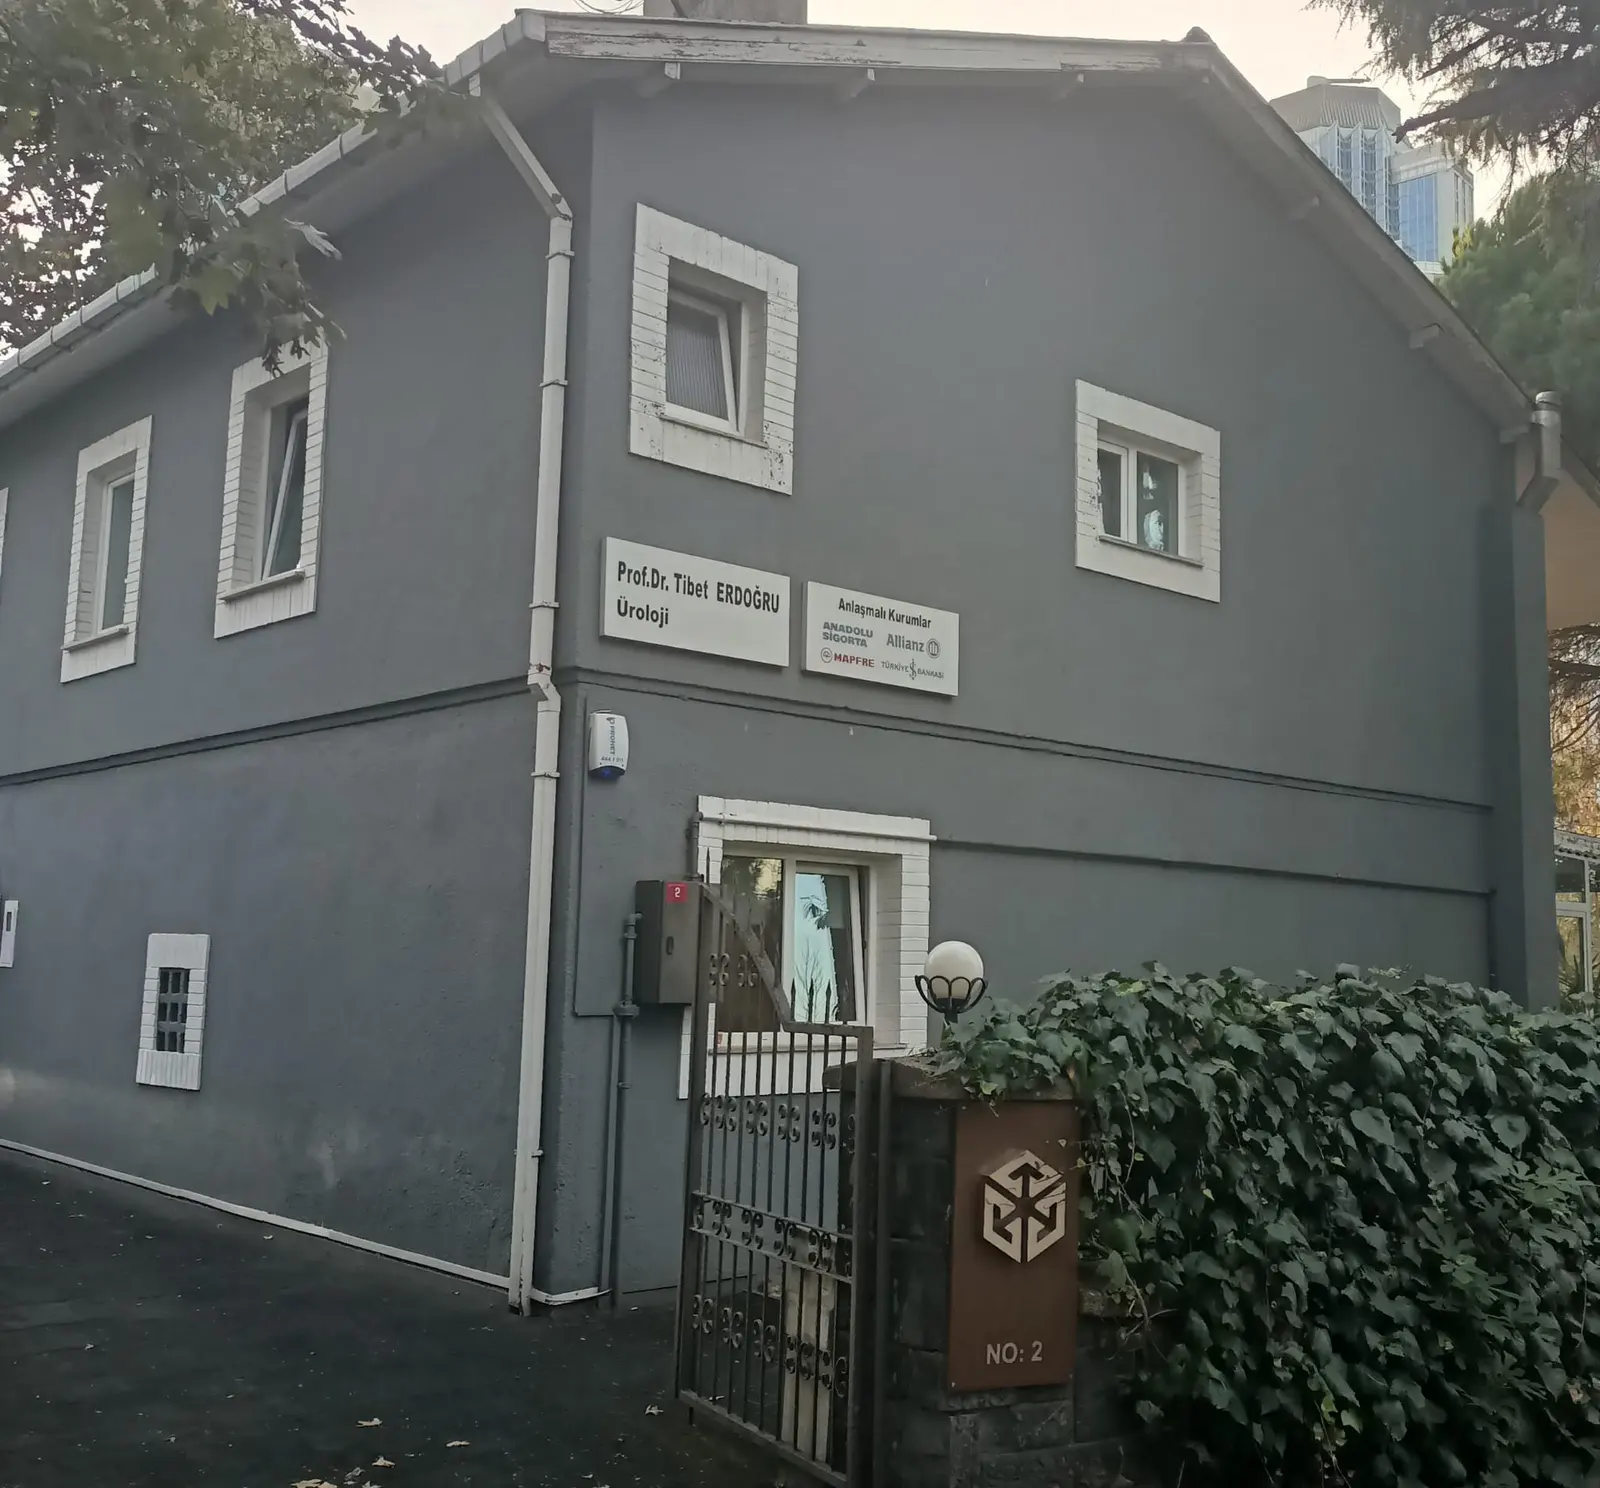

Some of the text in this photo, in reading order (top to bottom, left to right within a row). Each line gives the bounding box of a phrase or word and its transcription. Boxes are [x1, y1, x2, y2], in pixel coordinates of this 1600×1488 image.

[618, 561, 780, 613] Prof.Dr. Tibet ERDOĞRU
[617, 596, 669, 628] Üroloji
[838, 598, 931, 629] Anlaşmalı Kurumlar
[822, 631, 868, 648] SİGORTA
[823, 622, 873, 638] ANADOLU
[886, 633, 925, 653] Allianz
[833, 652, 875, 668] MAPFRE
[674, 887, 681, 898] 2
[986, 1340, 1043, 1365] NO: 2
